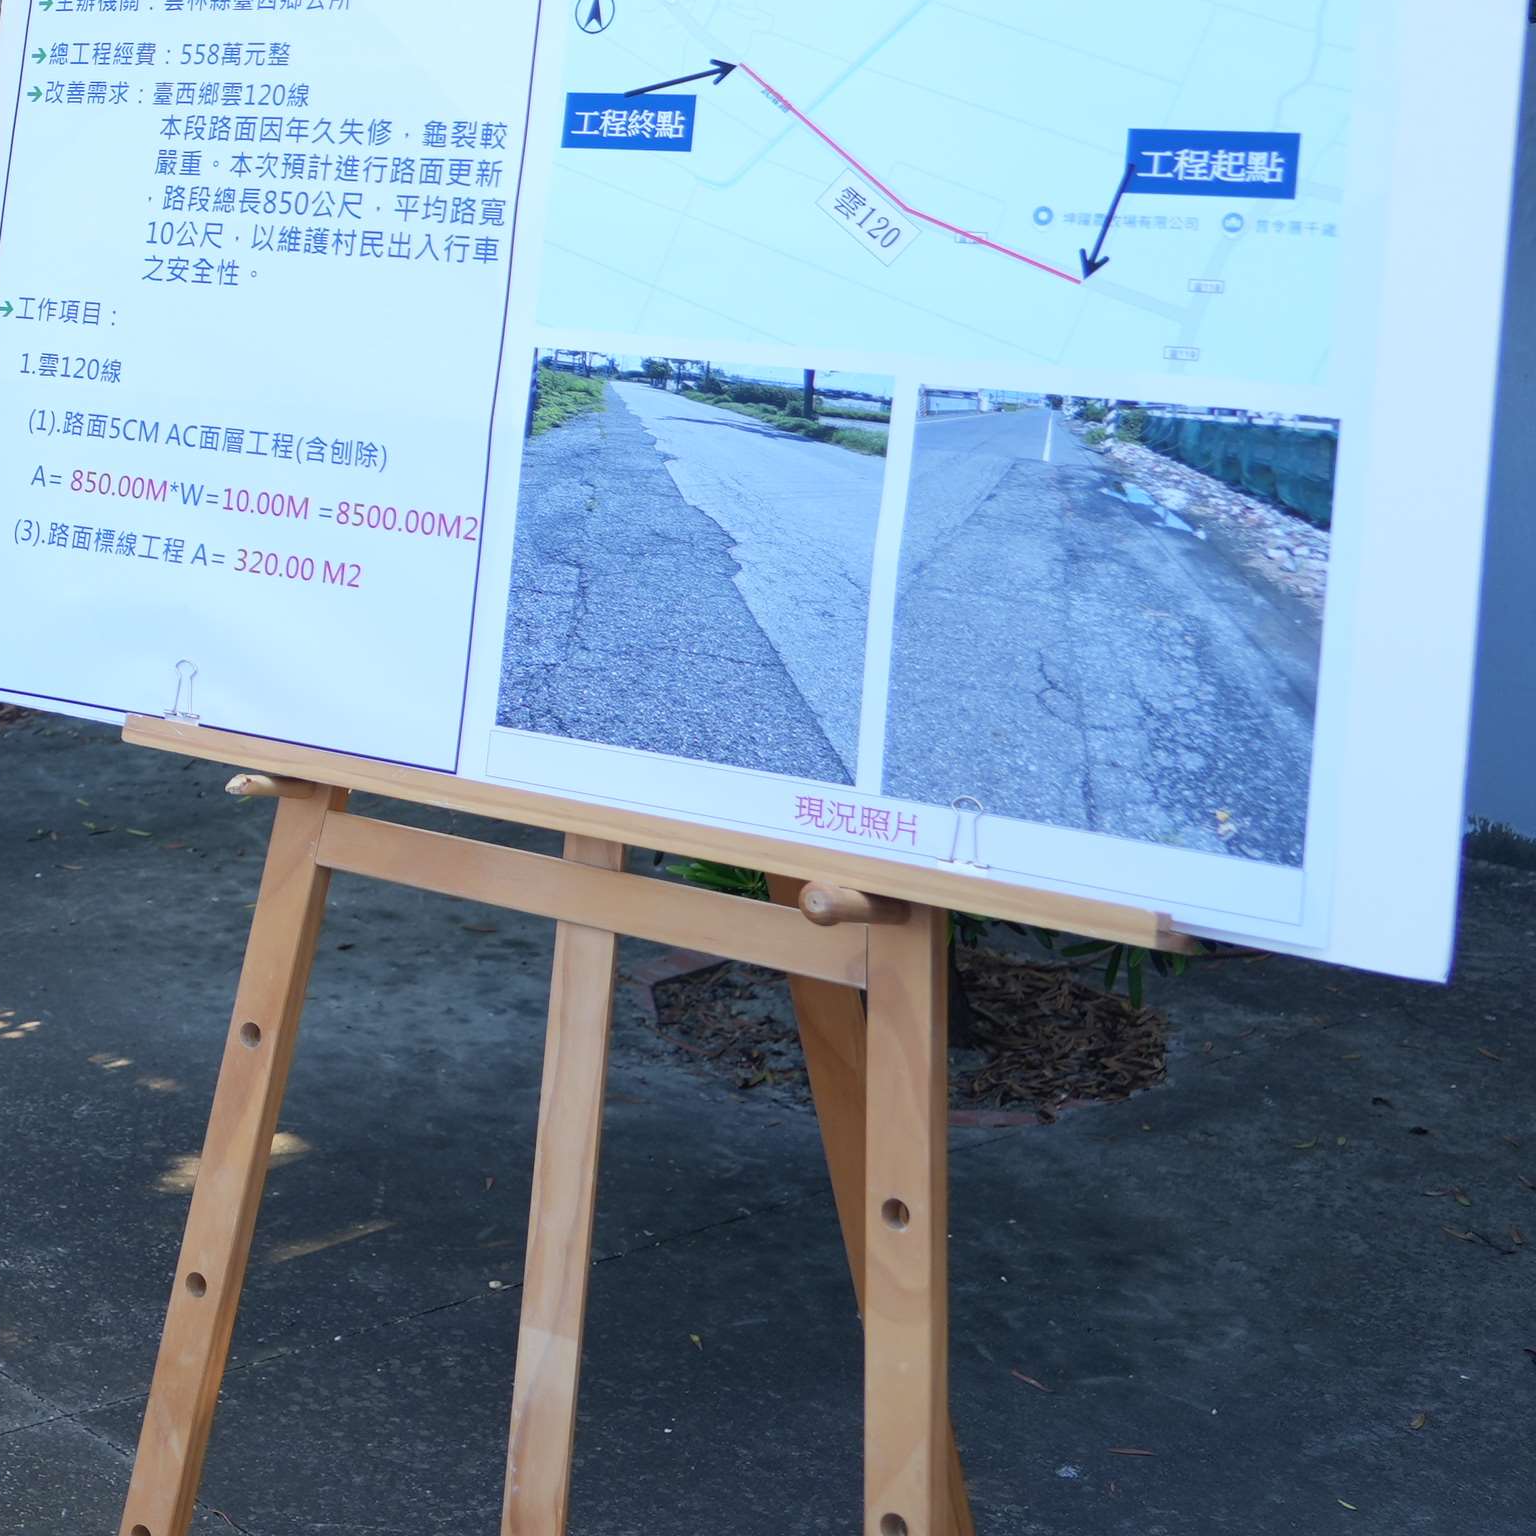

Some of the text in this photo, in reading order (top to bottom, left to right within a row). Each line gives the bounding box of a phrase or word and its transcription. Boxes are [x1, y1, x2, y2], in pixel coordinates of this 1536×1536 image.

[571, 109, 686, 139] 工程終點
[1136, 149, 1286, 183] 工程起點
[834, 186, 901, 248] 雲120
[19, 352, 122, 384] 1.雲120線
[14, 518, 185, 565] (3).路面標線工程
[234, 548, 315, 582] 320.00
[322, 560, 362, 588] M2
[794, 795, 917, 847] 現況照片
